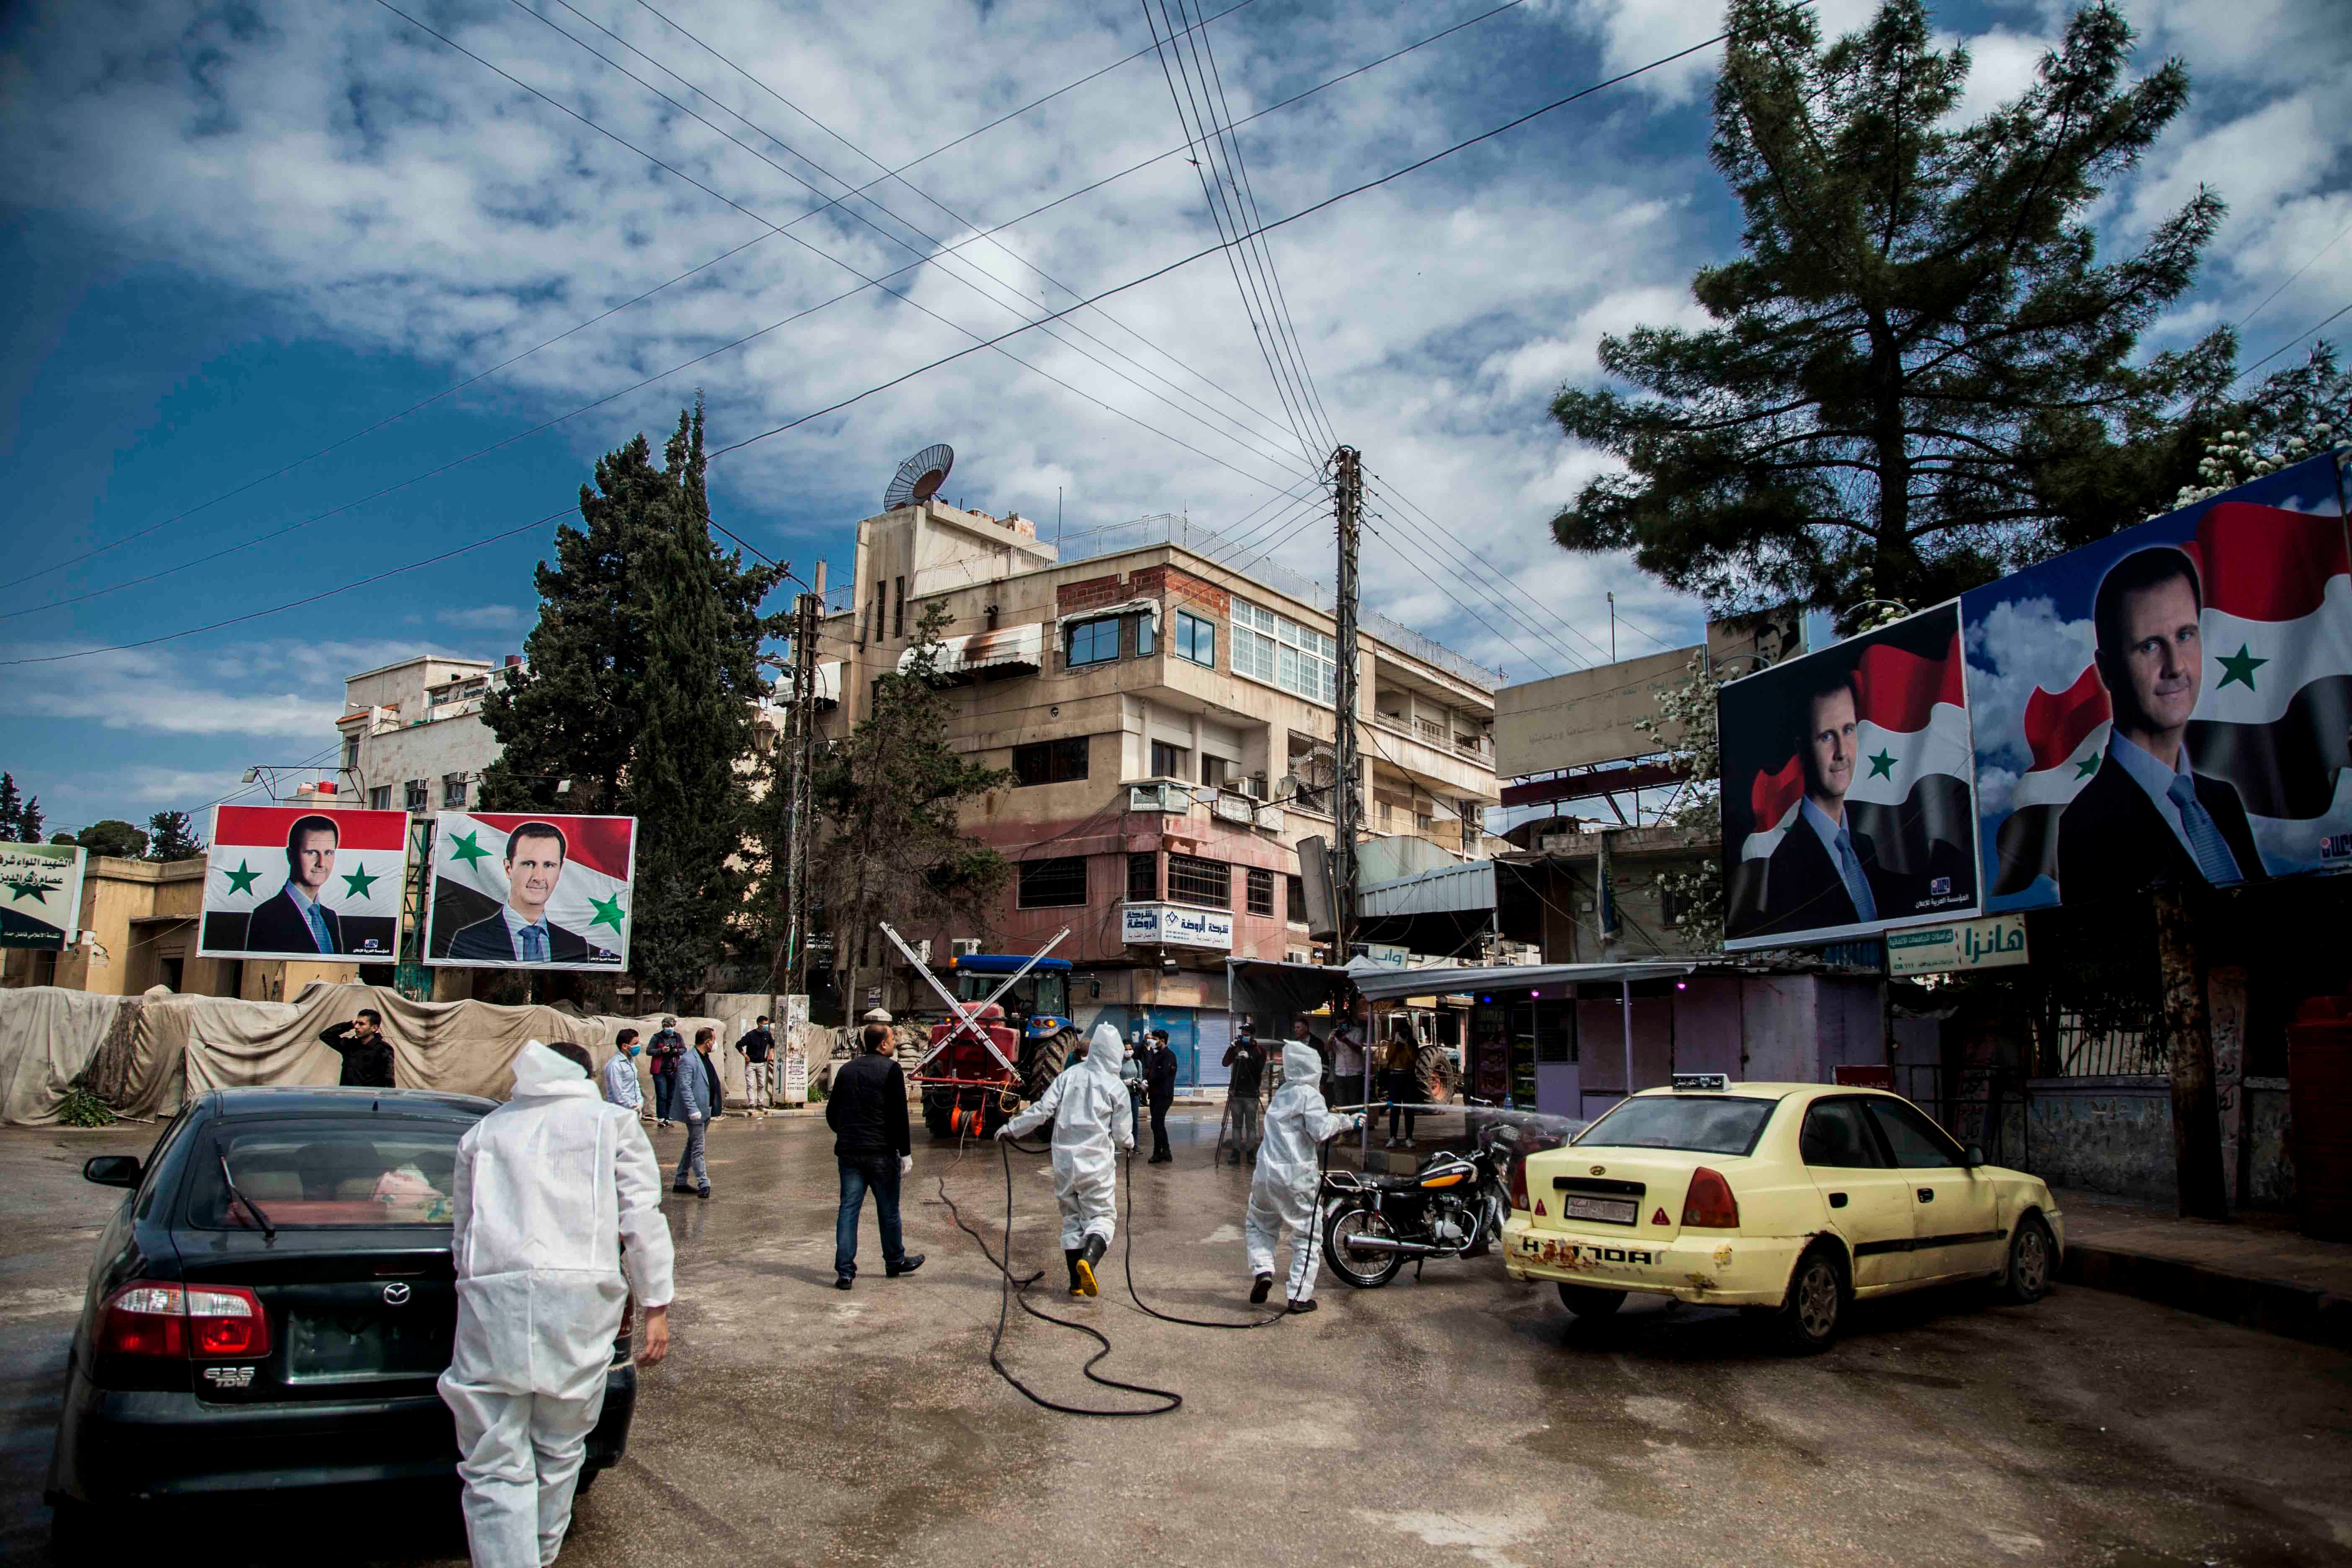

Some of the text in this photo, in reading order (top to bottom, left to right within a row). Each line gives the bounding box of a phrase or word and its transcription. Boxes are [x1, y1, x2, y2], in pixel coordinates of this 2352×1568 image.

[17, 858, 40, 868] اللواء
[41, 857, 71, 869] الشهيد
[39, 875, 64, 887] عصام
[1127, 910, 1153, 919] شركة
[1127, 915, 1157, 930] الروضة
[1181, 915, 1228, 935] شركة الروضة
[1965, 924, 2024, 965] هانزا
[204, 1367, 255, 1379] 626
